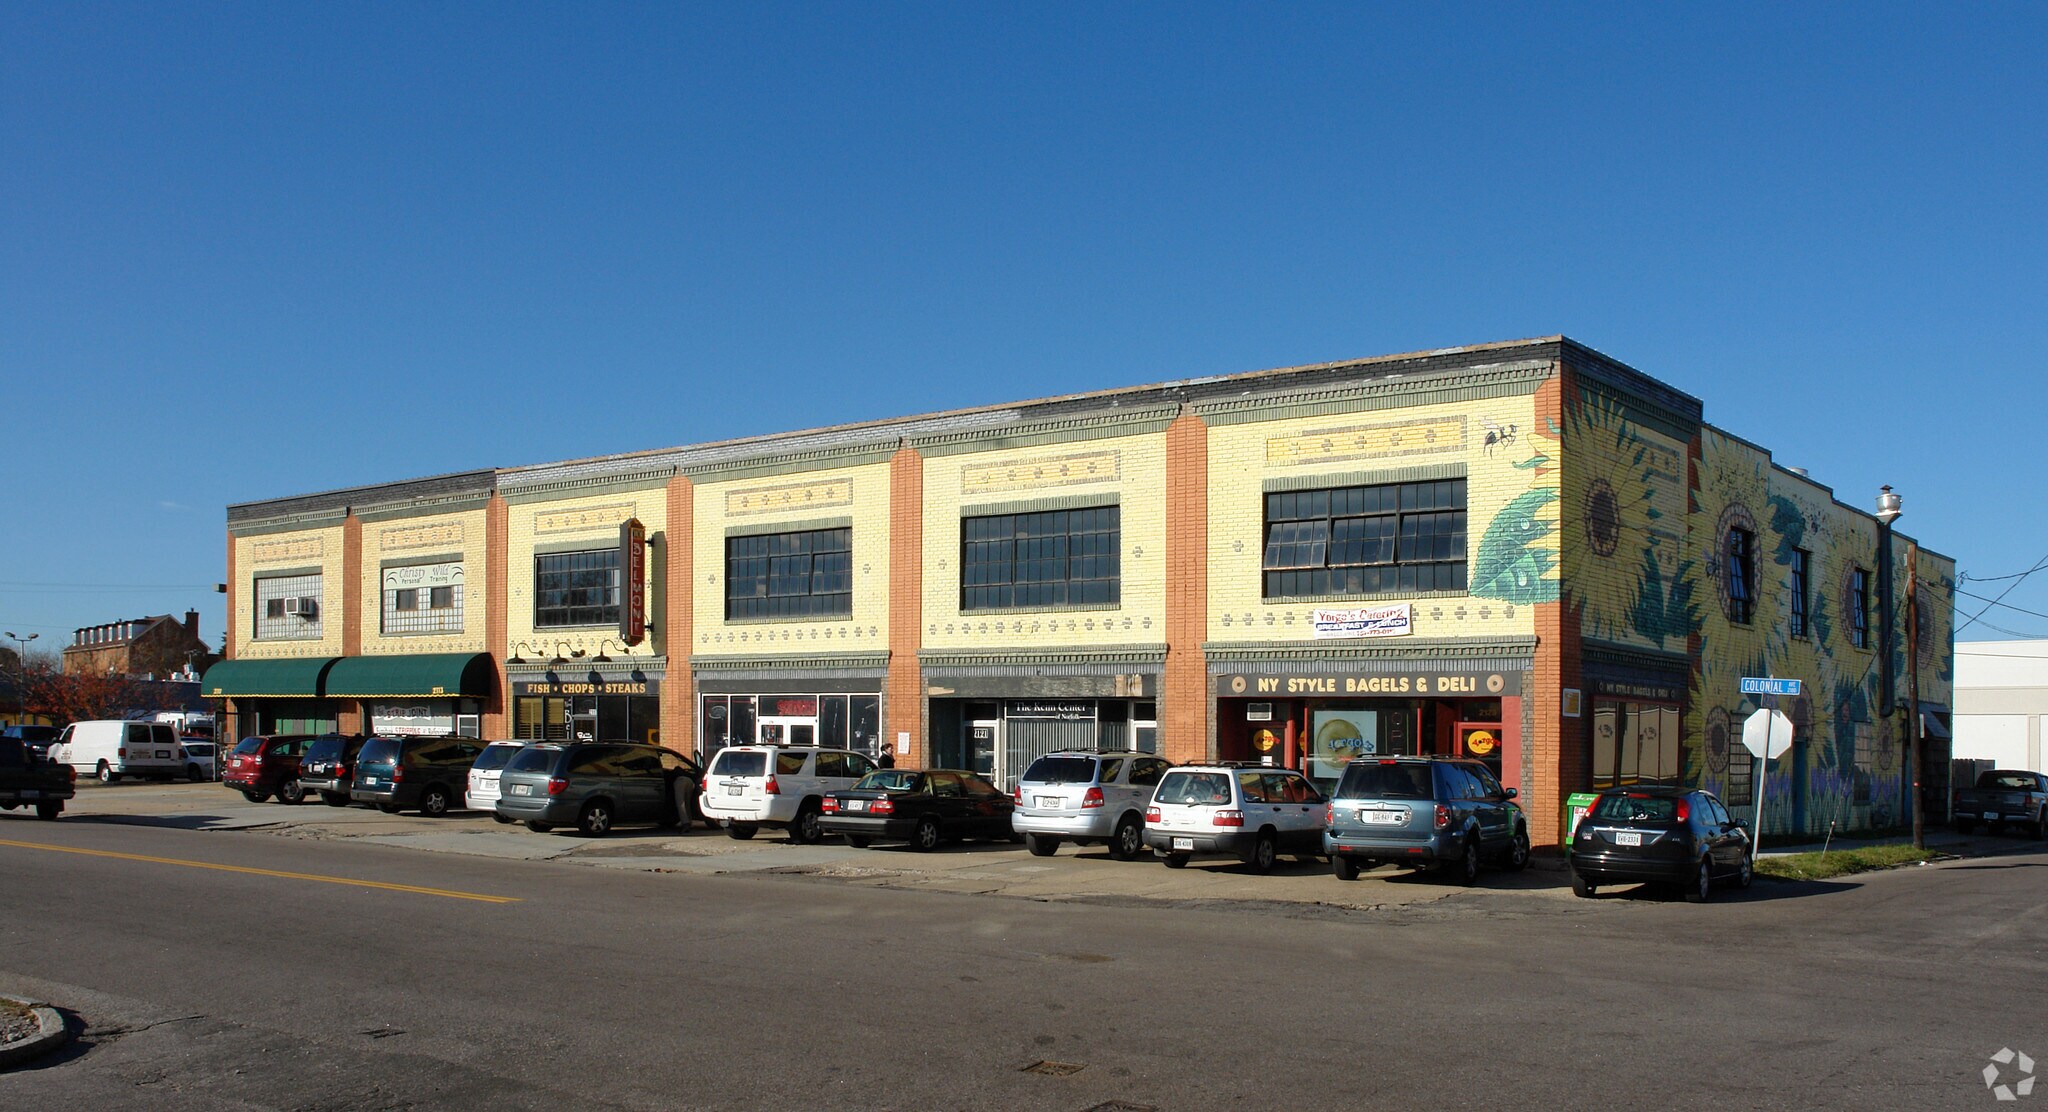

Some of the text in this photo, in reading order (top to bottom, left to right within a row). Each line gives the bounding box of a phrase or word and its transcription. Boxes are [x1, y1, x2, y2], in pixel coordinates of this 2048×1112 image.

[632, 542, 642, 631] BELMONT
[527, 683, 646, 693] FISH CHOPS STEAKS
[1257, 677, 1476, 692] NY STYLE BAGELS & DELI
[1745, 680, 1783, 692] COLONIAL
[1016, 702, 1031, 711] The
[1058, 702, 1086, 711] Center
